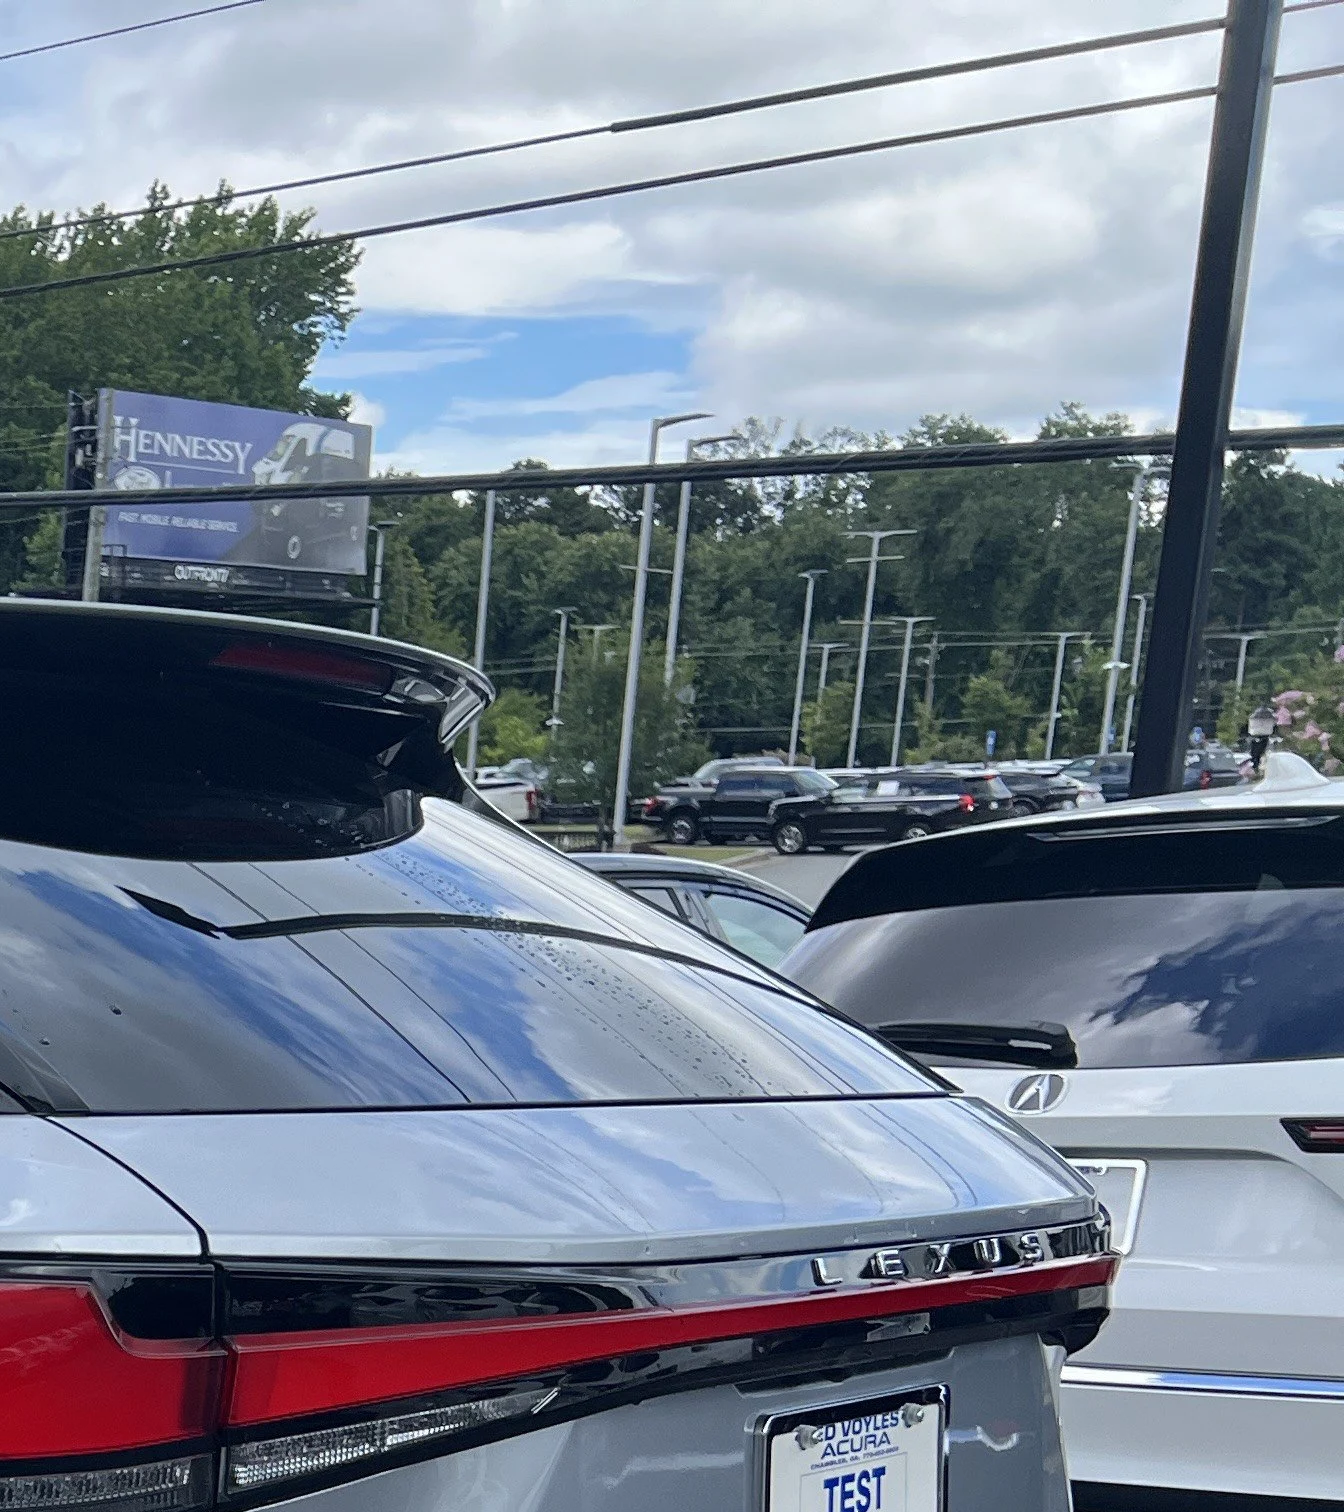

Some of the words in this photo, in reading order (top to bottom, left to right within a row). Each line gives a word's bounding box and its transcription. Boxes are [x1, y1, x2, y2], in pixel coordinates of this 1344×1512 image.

[113, 416, 253, 475] HENNESSY
[812, 1232, 1045, 1286] LEXUS
[841, 1409, 900, 1437] VOYLES
[820, 1431, 891, 1460] ACURA
